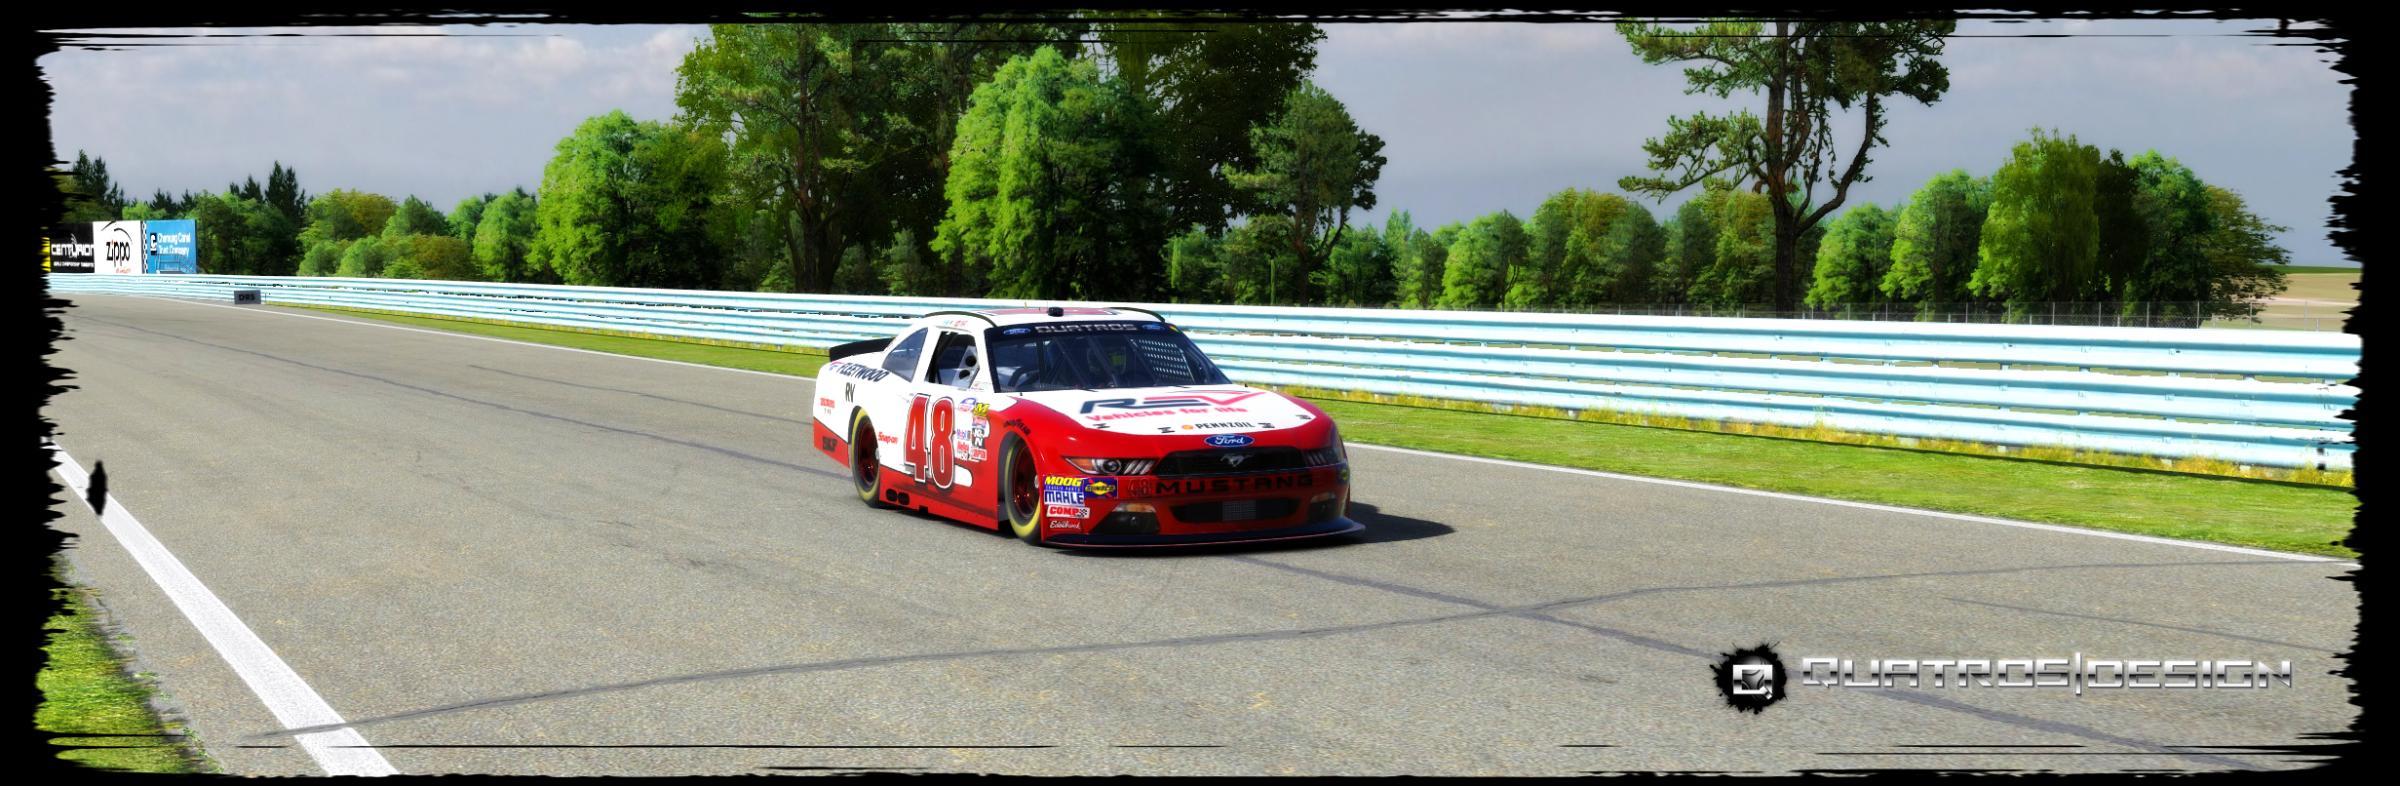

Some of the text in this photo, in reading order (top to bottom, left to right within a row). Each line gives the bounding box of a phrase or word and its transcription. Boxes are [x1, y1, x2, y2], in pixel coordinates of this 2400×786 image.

[106, 240, 131, 267] zippo
[1034, 323, 1138, 334] QUATROS
[845, 382, 855, 403] RV
[1086, 409, 1176, 422] Vehicles
[1179, 407, 1209, 416] for
[1196, 421, 1255, 430] PENNZOIL
[904, 392, 955, 490] 48
[1214, 436, 1246, 445] Ford
[1045, 476, 1082, 487] MOOG
[1155, 475, 1312, 494] MUSTANG
[1045, 491, 1084, 505] MAHLE
[1049, 506, 1080, 516] COMP
